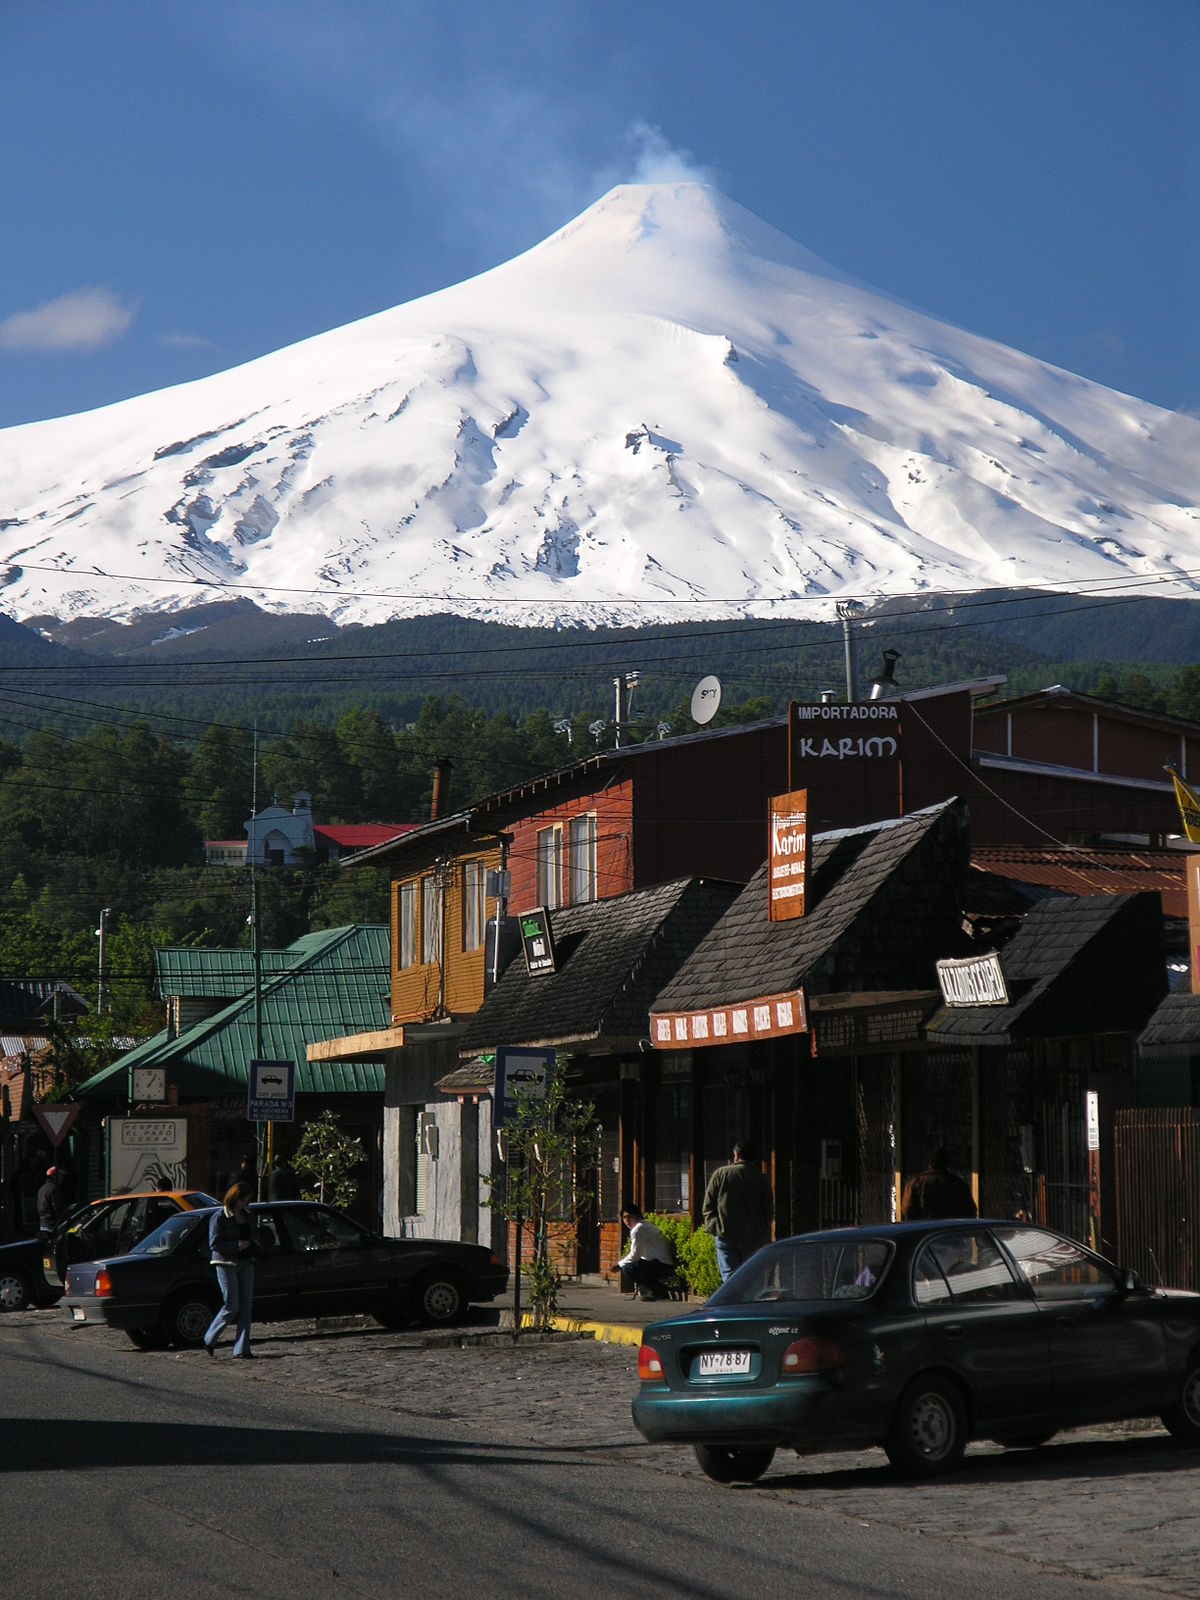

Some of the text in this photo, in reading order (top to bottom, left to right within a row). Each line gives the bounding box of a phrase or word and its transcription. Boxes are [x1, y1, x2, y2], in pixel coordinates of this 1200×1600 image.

[799, 707, 898, 719] IMPORTADORA
[800, 737, 897, 760] KARIM
[772, 815, 806, 858] Karim
